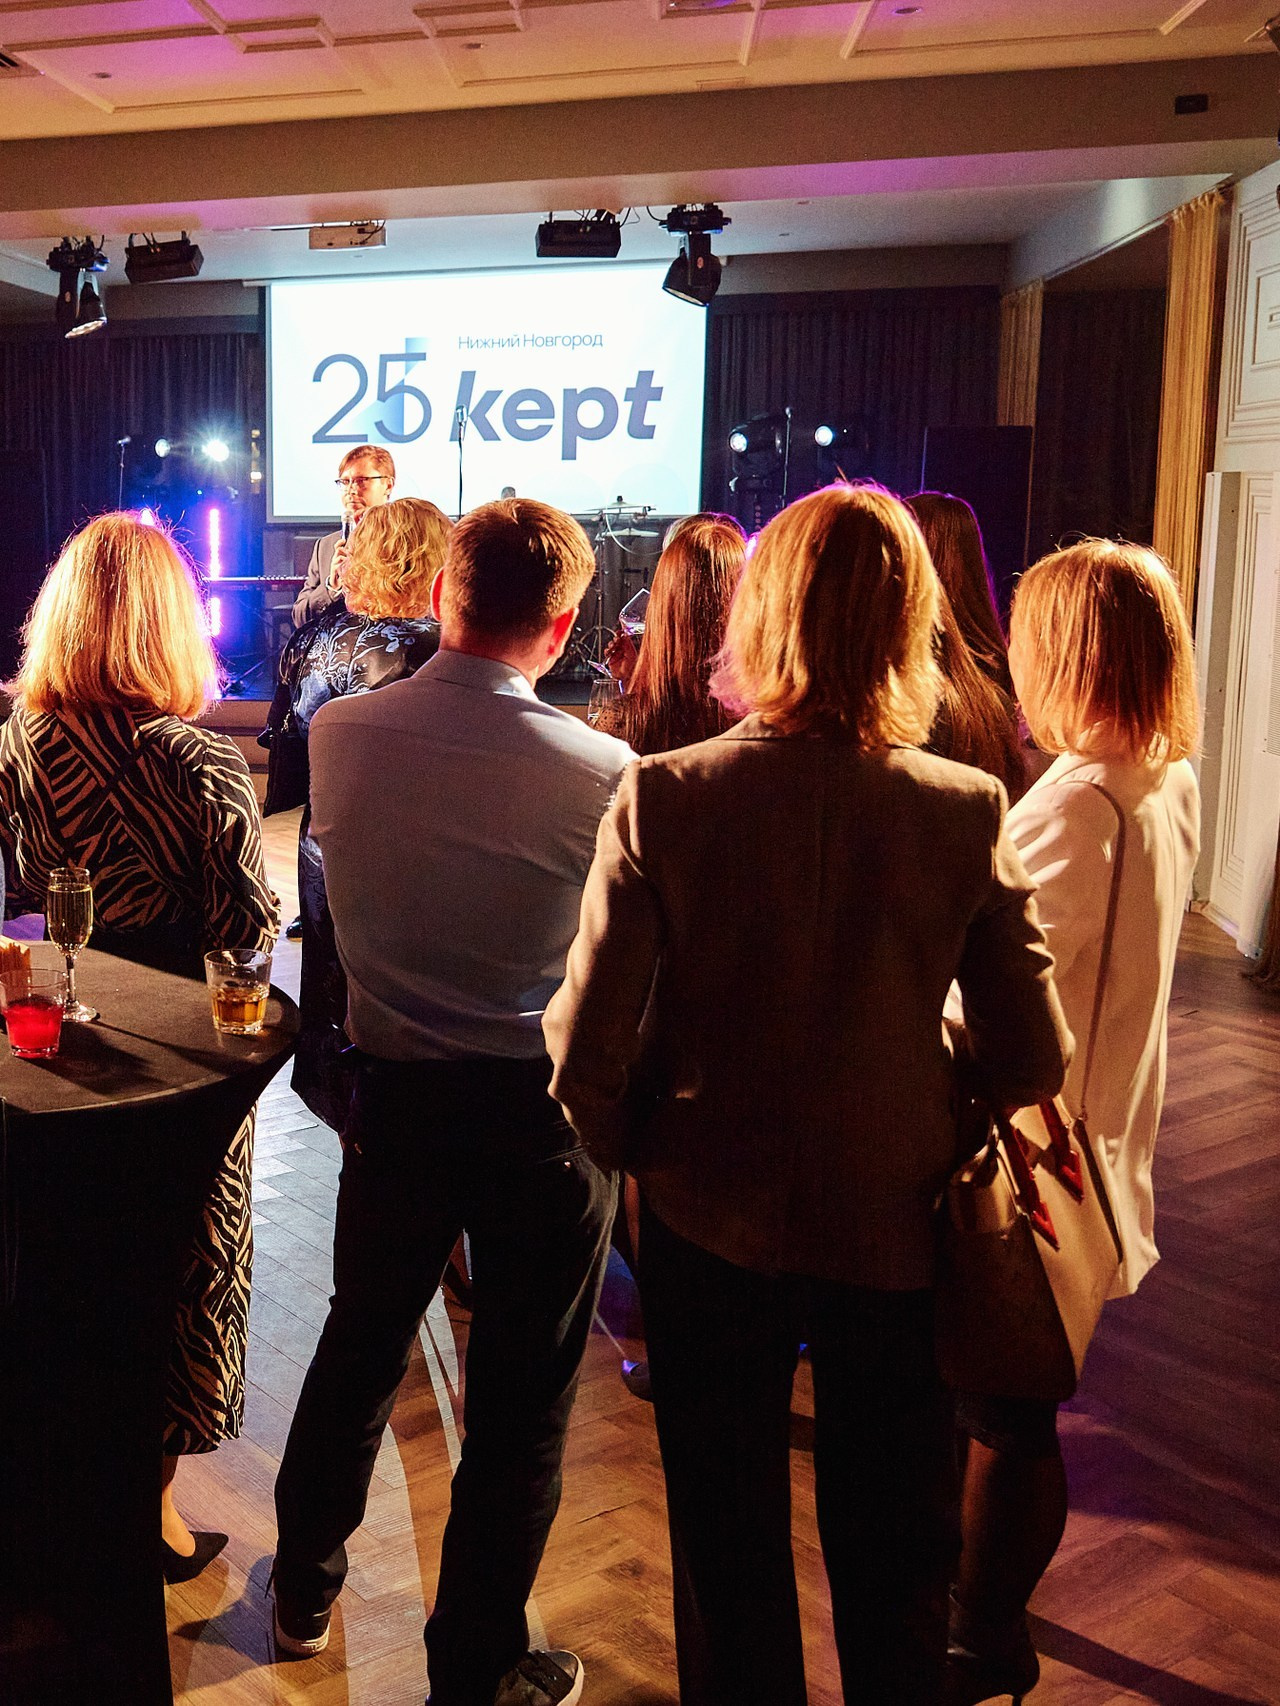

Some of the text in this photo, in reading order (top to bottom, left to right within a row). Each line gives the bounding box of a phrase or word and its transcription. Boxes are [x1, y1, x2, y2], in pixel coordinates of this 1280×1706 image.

[458, 333, 603, 350] Нижний Новгород
[312, 352, 663, 460] 25 kept
